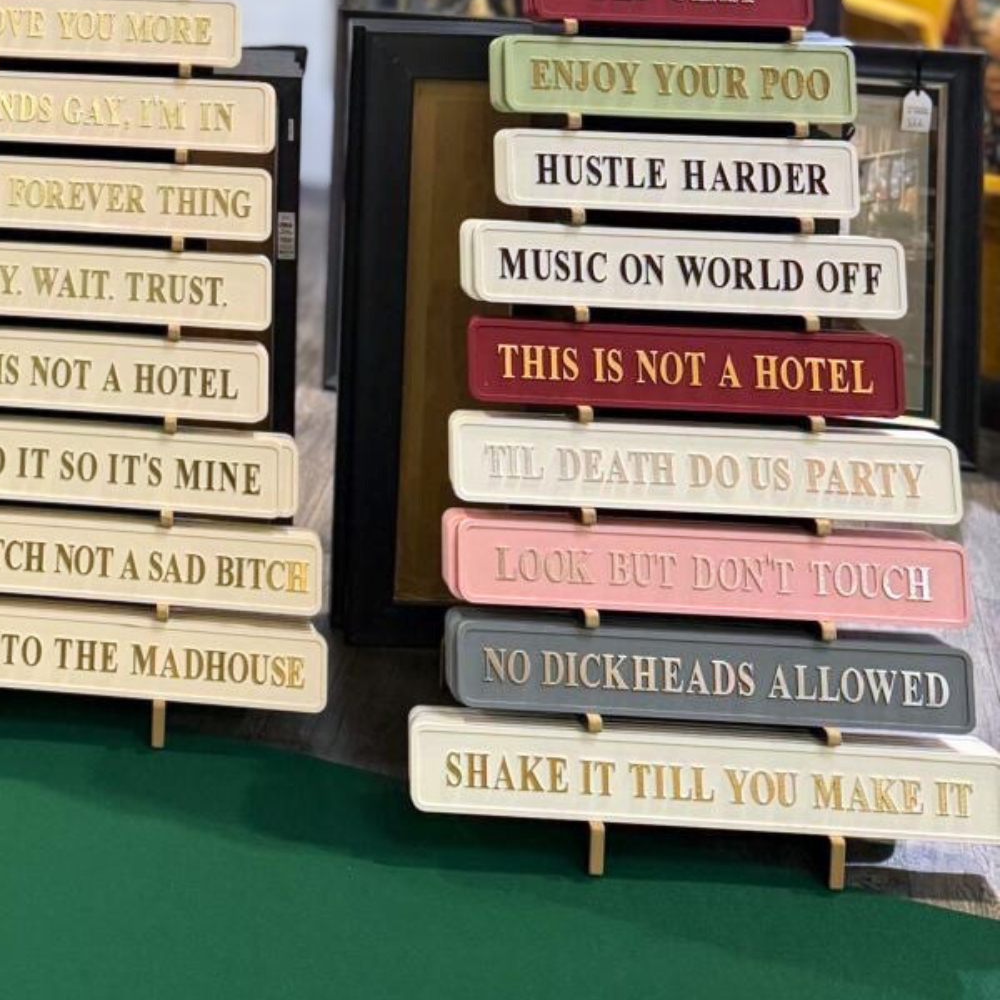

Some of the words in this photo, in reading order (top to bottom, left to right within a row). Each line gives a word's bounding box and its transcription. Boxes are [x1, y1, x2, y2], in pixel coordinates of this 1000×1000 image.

[57, 10, 117, 40] YOU
[125, 14, 213, 45] MORE
[530, 58, 642, 94] ENJOY
[653, 63, 749, 99] YOUR
[760, 67, 831, 101] POO
[62, 96, 131, 129] GAY,
[140, 96, 187, 130] I'M
[199, 104, 235, 132] IN
[8, 177, 145, 213] FOREVER
[157, 186, 252, 218] THING
[535, 153, 667, 189] HUSTLE
[683, 159, 829, 196] HARDER
[32, 266, 114, 300] WAIT.
[125, 271, 228, 308] TRUST.
[498, 247, 608, 284] MUSIC
[620, 253, 665, 285] ON
[676, 255, 804, 291] WORLD
[816, 261, 883, 295] OFF
[30, 356, 92, 390] NOT
[103, 363, 122, 392] A
[134, 363, 239, 400] HOTEL
[498, 343, 579, 382] THIS
[593, 347, 623, 383] IS
[636, 349, 706, 387] NOT
[719, 355, 739, 389] A
[754, 355, 874, 394] HOTEL
[16, 446, 48, 478] IT
[59, 451, 98, 481] SO
[107, 452, 163, 487] IT'S
[175, 458, 261, 496] MINE
[556, 446, 675, 487] DEATH
[689, 453, 740, 489] DO
[750, 456, 791, 493] US
[805, 458, 924, 499] PARTY
[54, 543, 114, 578] NOT
[121, 549, 140, 580] A
[148, 551, 205, 585] SAD
[216, 554, 309, 593] BITCH
[495, 546, 593, 586] LOOK
[609, 552, 676, 588] BUT
[693, 553, 794, 593] DON'T
[808, 561, 932, 601] TOUCH
[1, 633, 42, 667] TO
[55, 638, 118, 673] THE
[132, 644, 305, 690] MADHOUSE
[482, 646, 531, 683] NO
[541, 651, 755, 697] DICKHEADS
[768, 664, 949, 707] ALLOWED
[445, 751, 568, 793] SHAKE
[580, 759, 616, 796] IT
[629, 763, 714, 803] TILL
[723, 769, 798, 807] YOU
[812, 774, 924, 815] MAKE
[934, 780, 974, 818] IT
